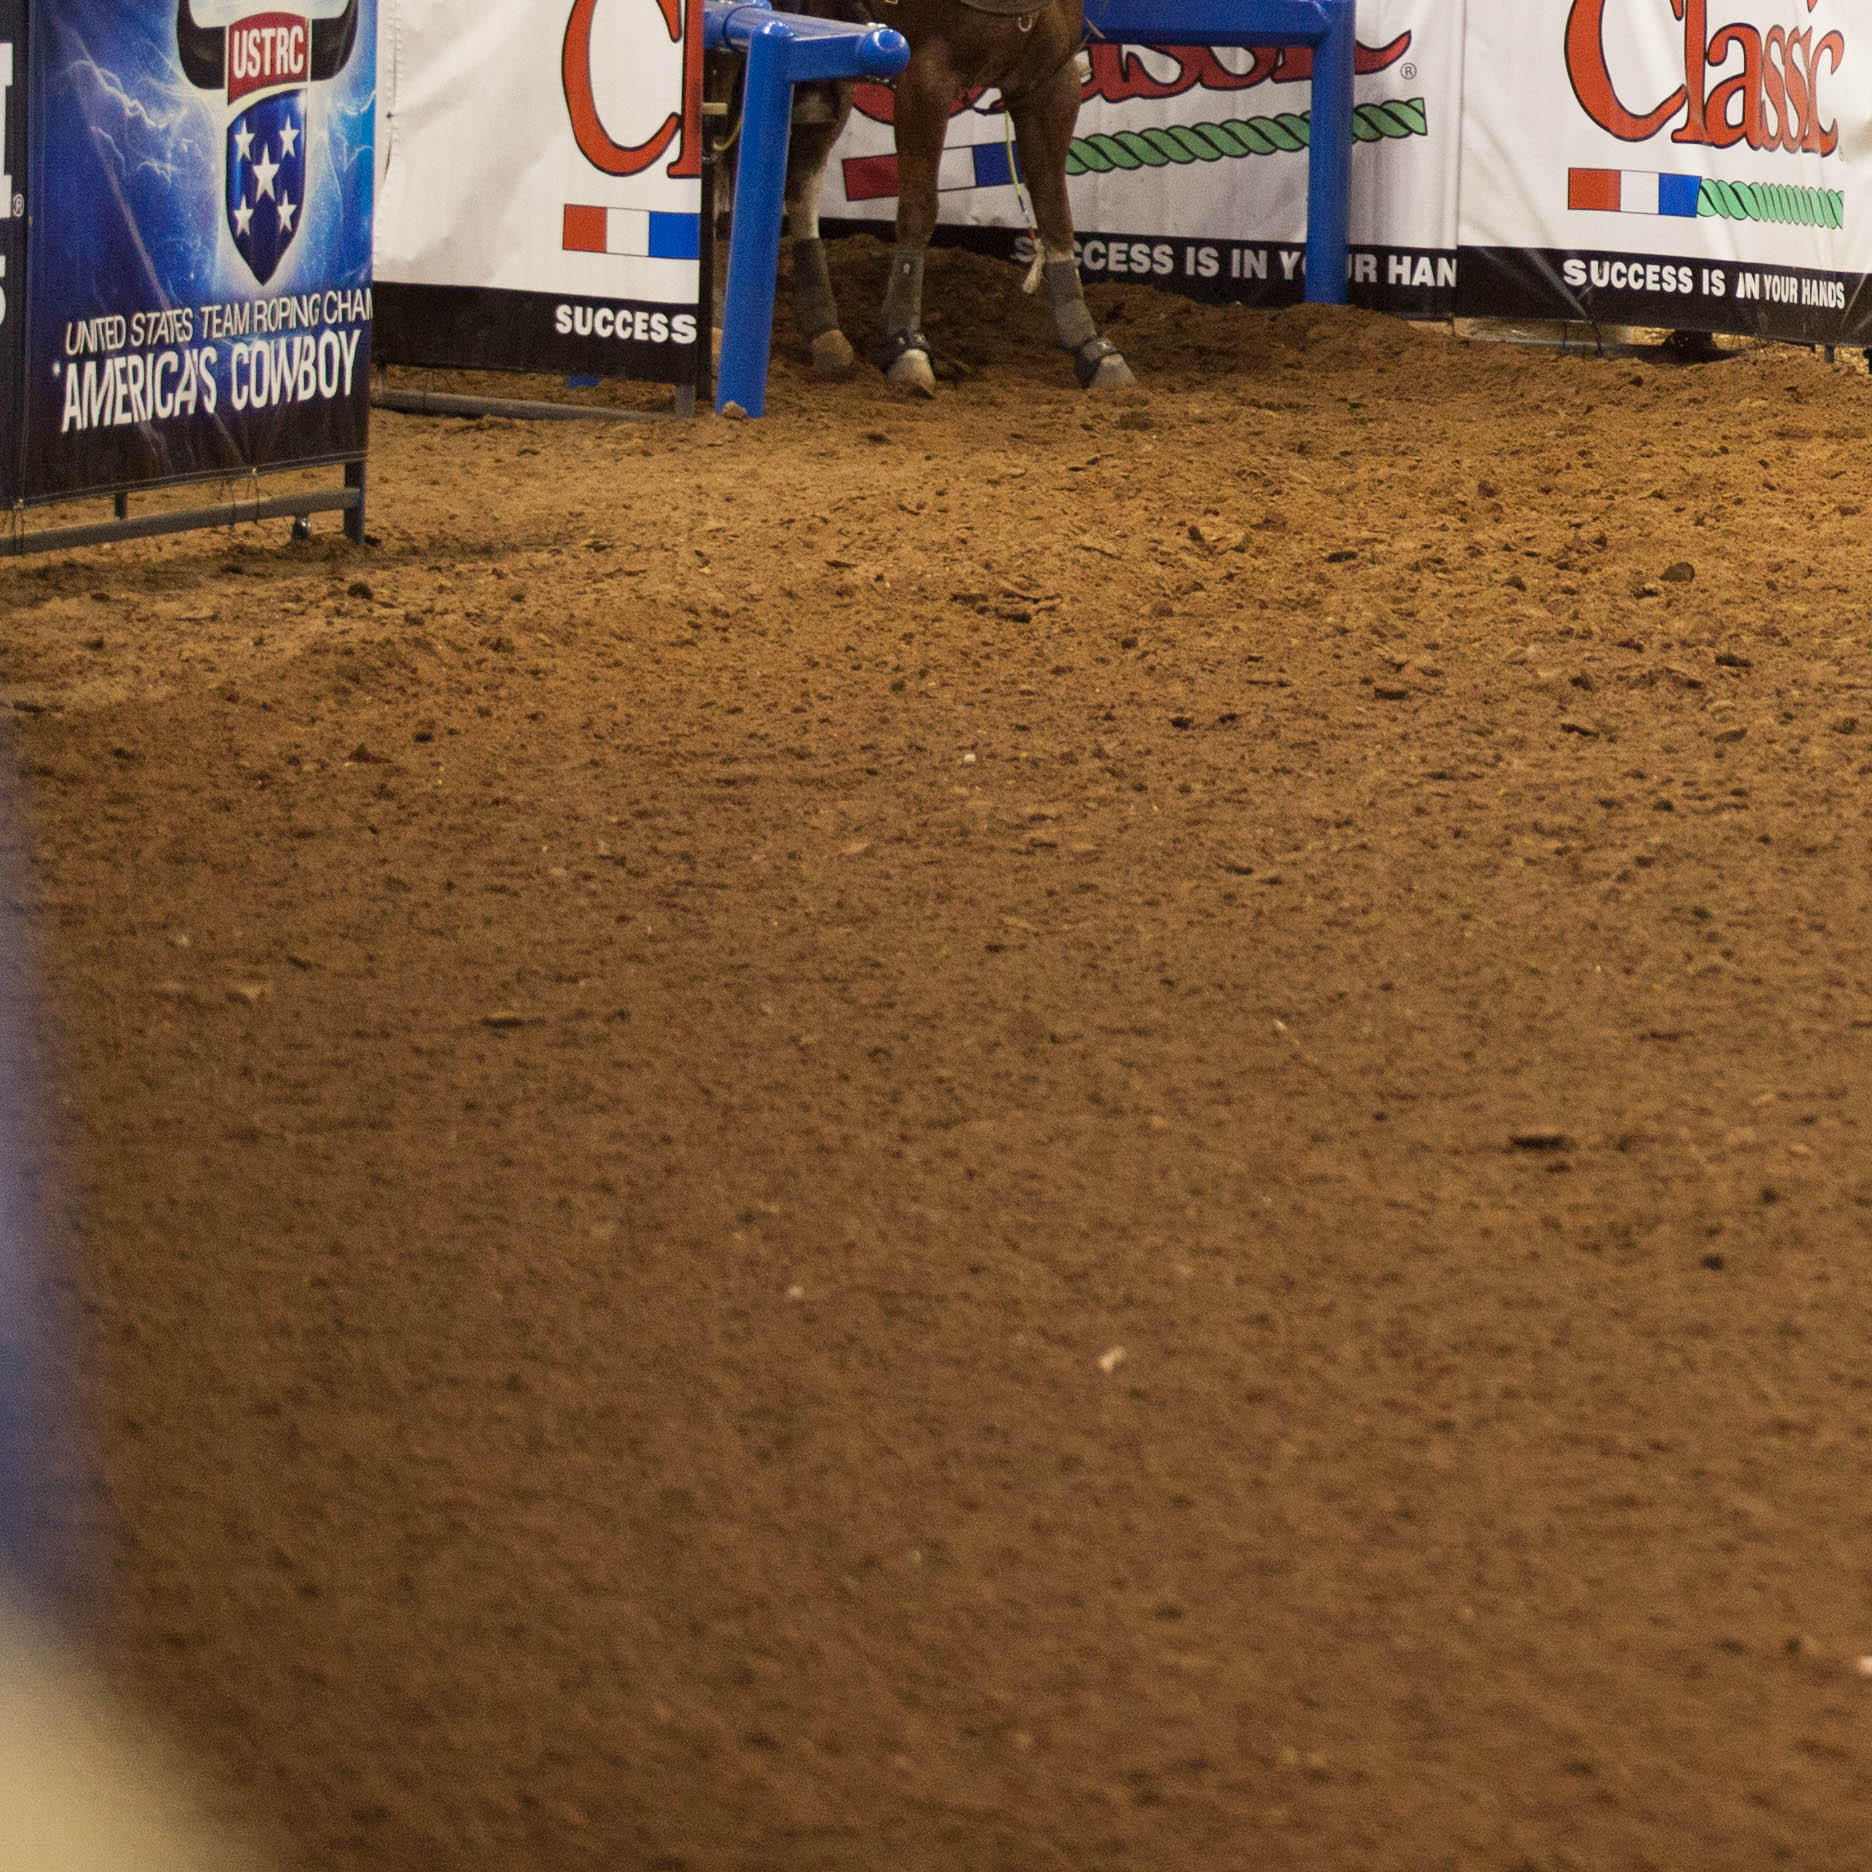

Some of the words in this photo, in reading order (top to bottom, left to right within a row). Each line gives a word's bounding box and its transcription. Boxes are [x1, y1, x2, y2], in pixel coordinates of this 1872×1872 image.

[233, 22, 305, 80] USTRC
[1185, 245, 1220, 278] IS
[1231, 248, 1267, 280] IN
[1562, 258, 1694, 295] SUCCESS
[1702, 267, 1726, 297] IS
[1735, 271, 1760, 300] IN
[1764, 274, 1799, 305] YOUR
[1801, 278, 1846, 310] HANDS
[65, 315, 126, 357] UNITED
[130, 307, 193, 347] STATES
[200, 302, 250, 340] TEAM
[254, 293, 321, 334] ROPING
[556, 304, 698, 345] SUCCESS
[231, 328, 362, 411] COWBOY
